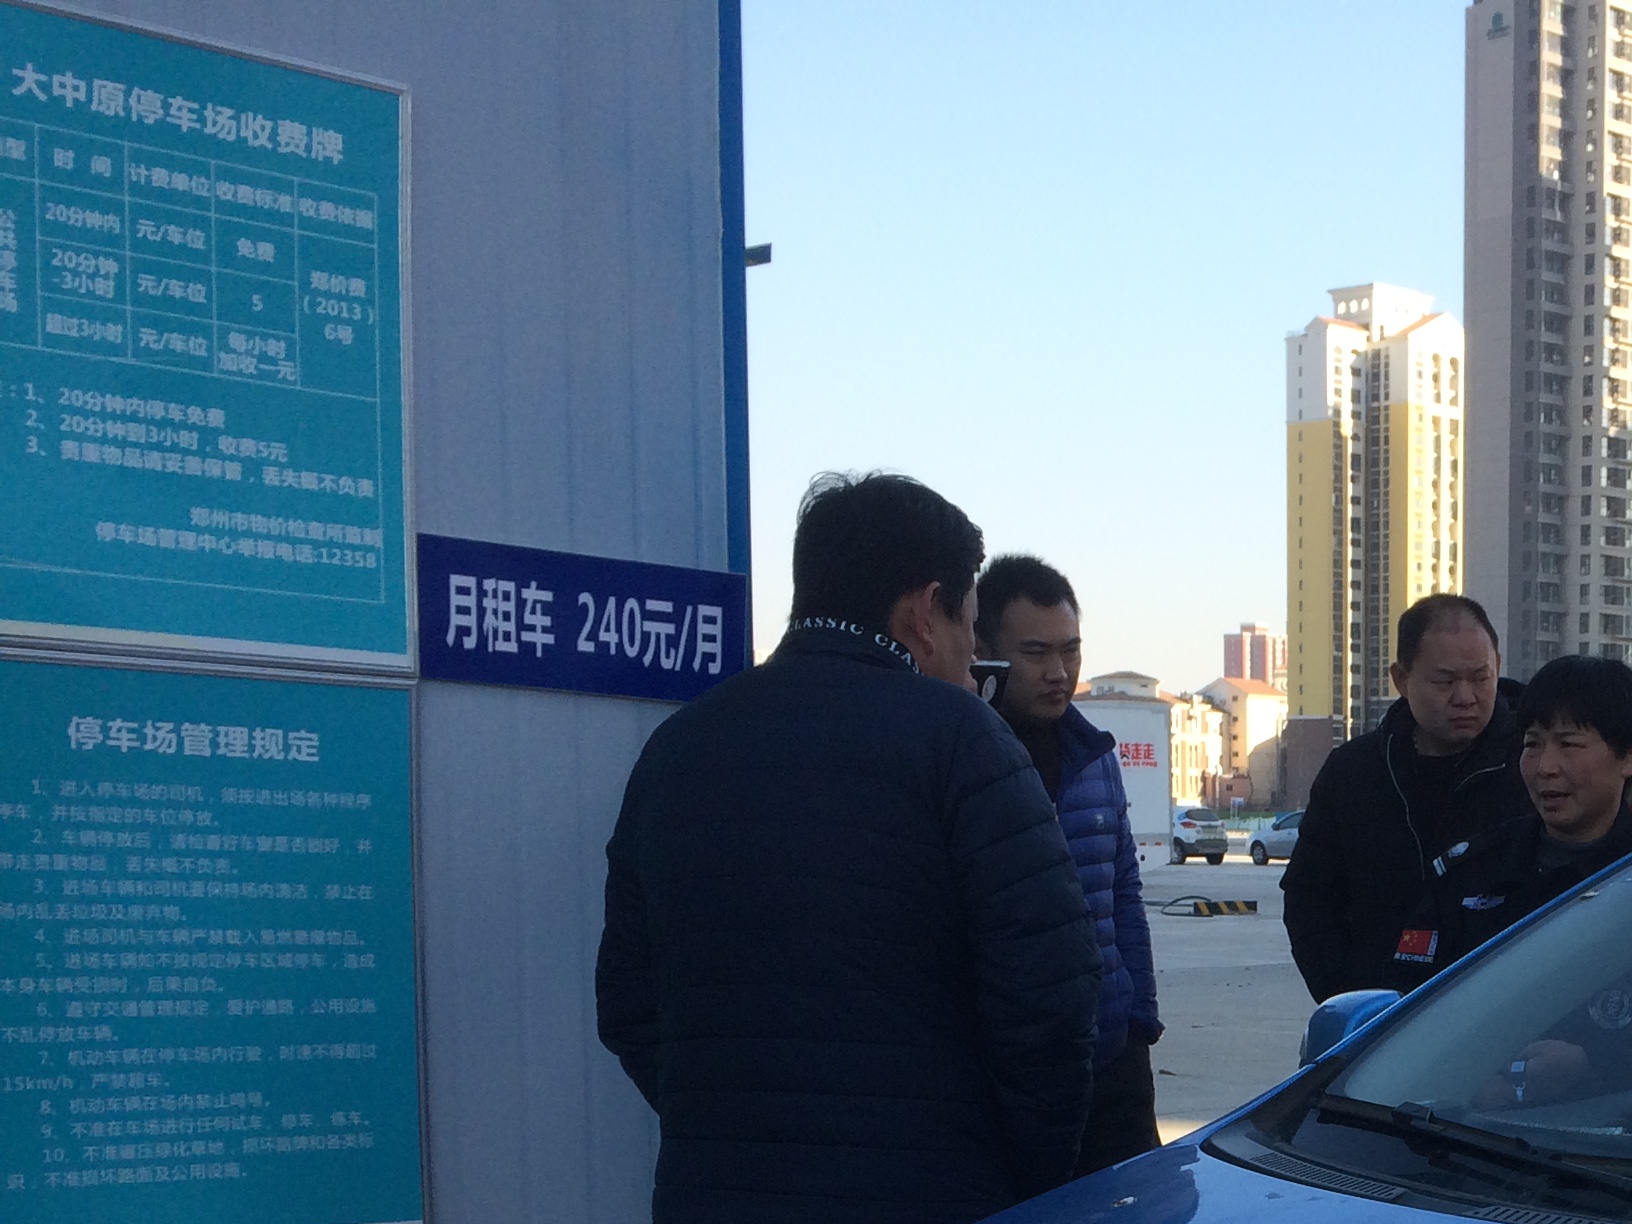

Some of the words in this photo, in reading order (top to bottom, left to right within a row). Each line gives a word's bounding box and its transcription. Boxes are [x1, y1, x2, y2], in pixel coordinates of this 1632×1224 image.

[12, 62, 344, 165] 大中原停车场收费牌
[130, 163, 211, 197] 计费单位
[216, 180, 294, 214] 收费标准
[45, 202, 121, 236] 20分钟内
[136, 219, 207, 250] 元/车位
[51, 248, 119, 277] 20分钟
[236, 237, 275, 263] 免费
[137, 273, 207, 305] 元/车位
[251, 294, 264, 312] 5
[138, 327, 209, 358] 元/车位
[446, 573, 555, 658] 月租车
[576, 591, 724, 675] 240元/月
[874, 633, 925, 676] CLAS
[67, 715, 320, 763] 停车场管理规定
